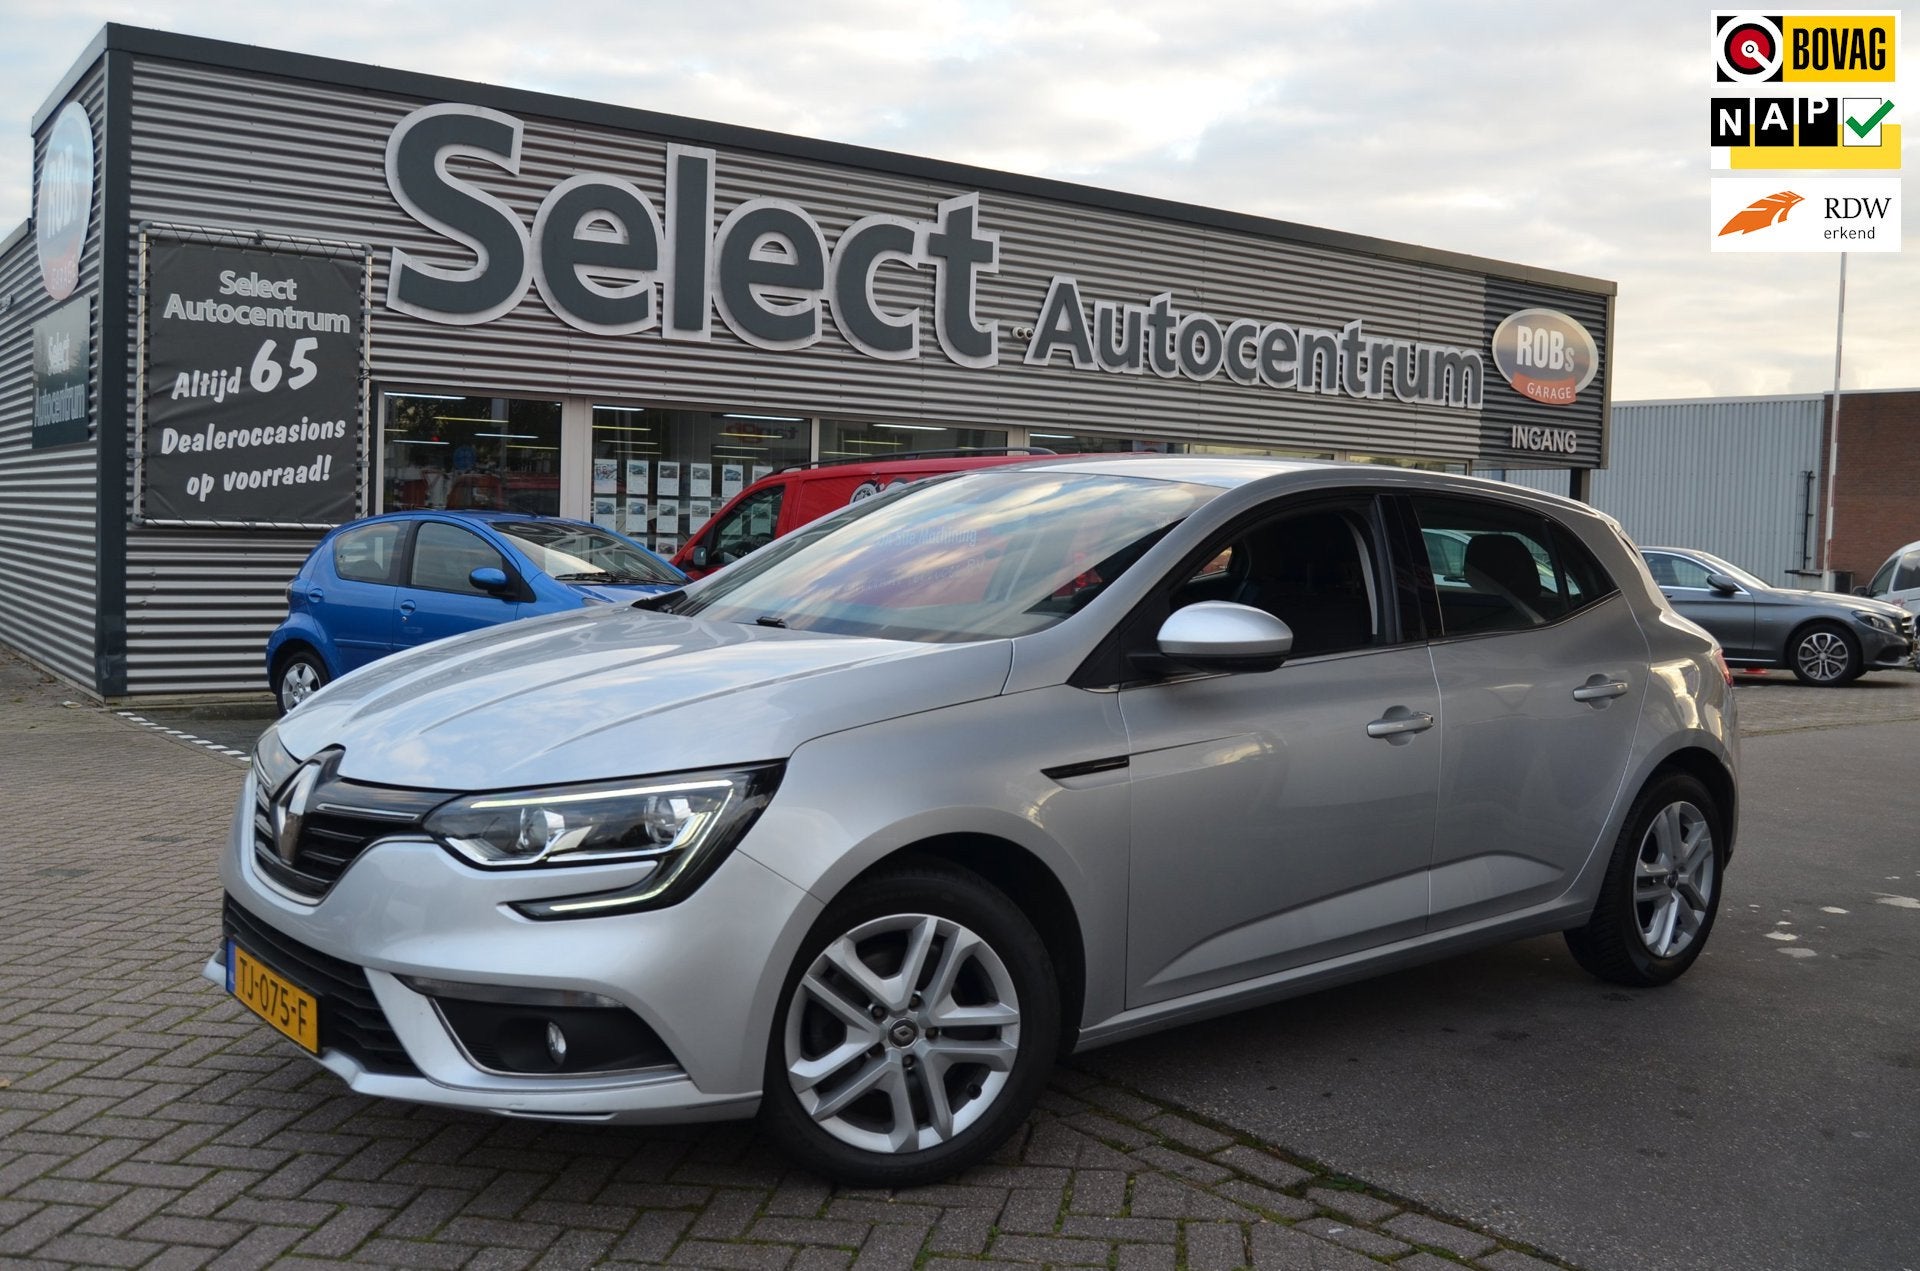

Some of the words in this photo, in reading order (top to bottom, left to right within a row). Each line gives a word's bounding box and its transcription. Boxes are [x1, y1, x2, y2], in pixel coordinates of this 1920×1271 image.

[384, 102, 1000, 370] Select
[219, 270, 298, 301] Select
[163, 293, 351, 334] Autocentrum
[1023, 275, 1484, 410] Autocentrum
[171, 366, 242, 403] Altijd
[250, 337, 319, 393] 65
[1526, 382, 1572, 400] GARAGE
[161, 416, 347, 455] Dealeroccasions
[1511, 425, 1577, 453] INGANG
[186, 473, 215, 502] op
[223, 454, 333, 492] voorraad!
[239, 956, 308, 1036] TJ-075-F
